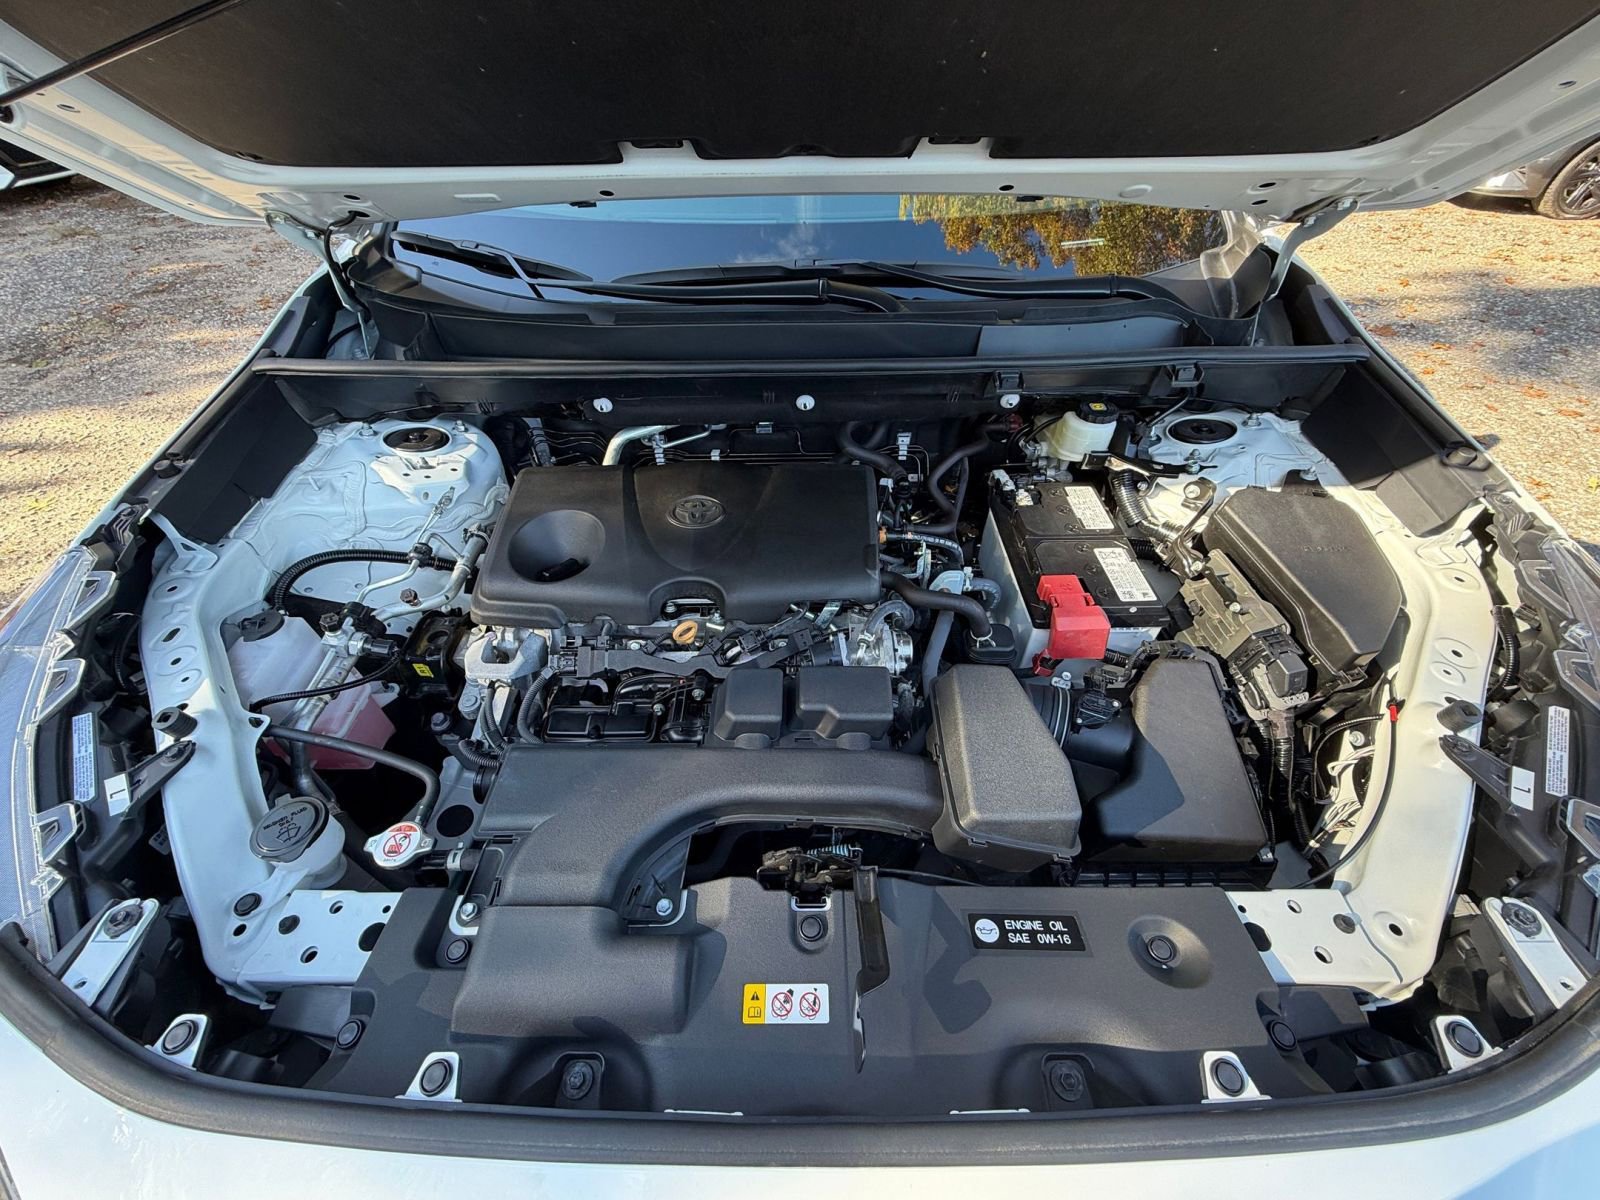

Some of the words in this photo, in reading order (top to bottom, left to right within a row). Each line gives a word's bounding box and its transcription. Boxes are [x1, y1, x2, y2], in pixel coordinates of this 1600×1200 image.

[1004, 919, 1044, 931] ENGINE
[1049, 920, 1068, 931] OIL
[1008, 932, 1031, 943] SAE
[1037, 933, 1072, 945] 0W-16
